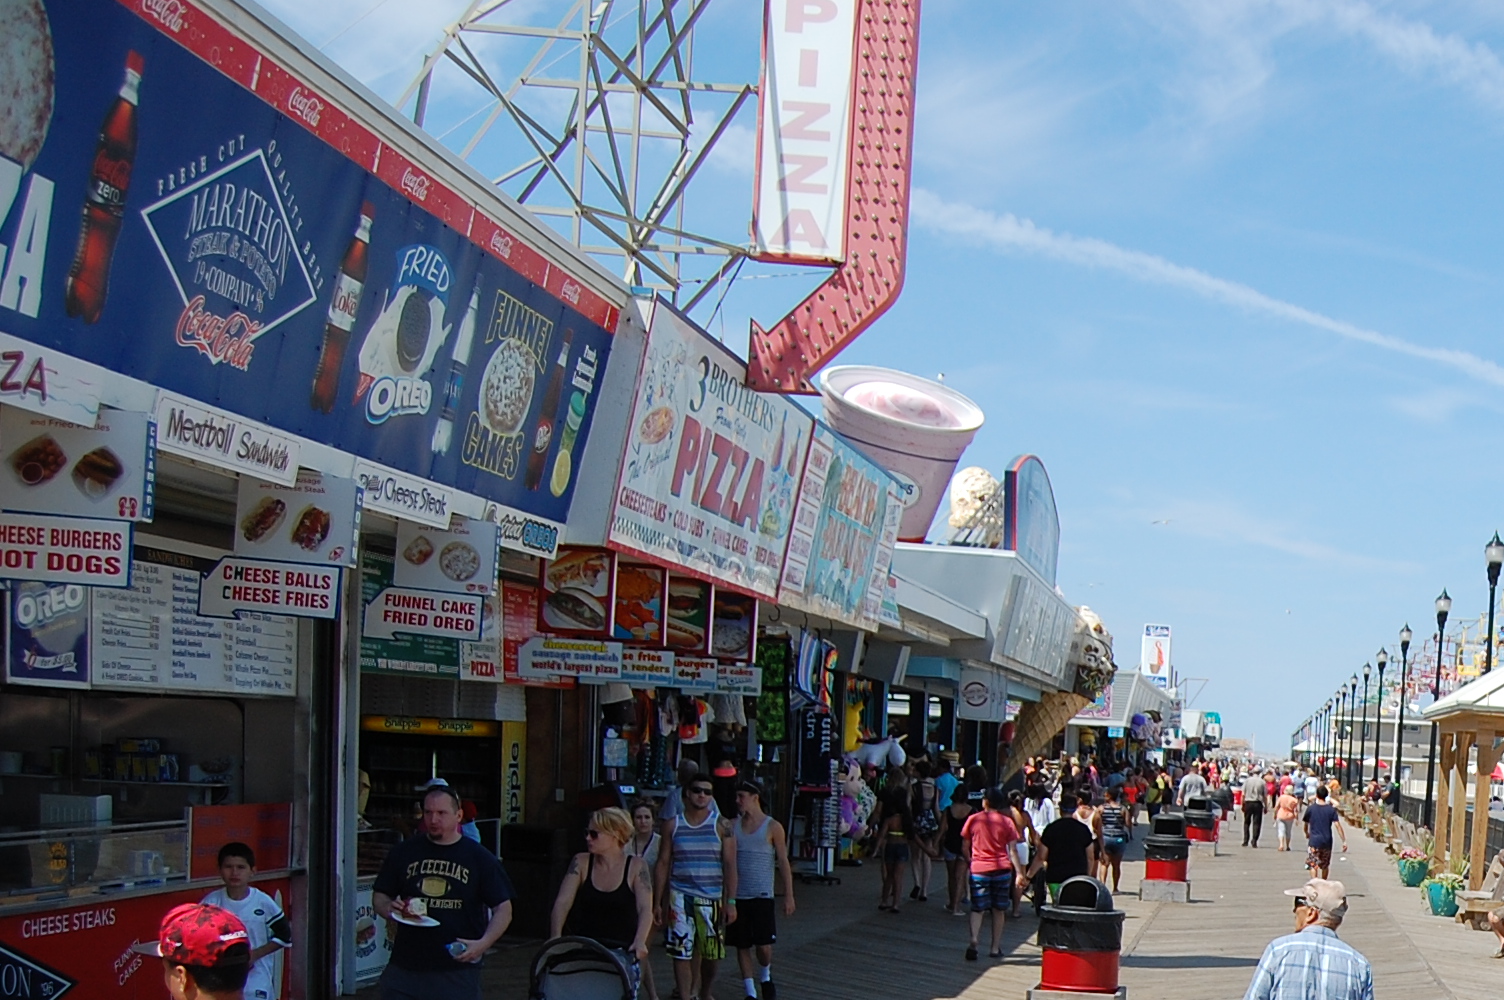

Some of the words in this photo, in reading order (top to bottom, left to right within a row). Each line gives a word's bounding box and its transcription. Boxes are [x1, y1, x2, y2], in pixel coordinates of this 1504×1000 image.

[288, 86, 325, 127] Coca-Cola
[768, 0, 838, 249] PIZZA
[157, 155, 208, 196] FRESH
[218, 134, 246, 162] CUT
[97, 180, 120, 203] zero
[268, 139, 304, 231] QUALITY
[184, 182, 291, 286] MARATHON
[187, 231, 228, 263] STEAK
[399, 246, 451, 292] FRIED
[206, 266, 252, 307] COMPANY
[333, 286, 357, 318] Coke
[176, 295, 264, 371] Coca-Cola
[485, 289, 554, 374] FUNNEL
[368, 377, 432, 421] OREO
[689, 355, 711, 412] 3
[708, 362, 776, 433] BROTHERS
[167, 407, 236, 455] Meatball
[237, 431, 290, 472] Sandwich
[462, 411, 525, 480] CAKES
[671, 414, 765, 533] PIZZA
[421, 489, 447, 516] Steak
[619, 486, 668, 523] CHEESESTEAKS
[673, 509, 689, 532] COLD
[710, 525, 731, 550] FUNNEL
[731, 535, 750, 556] CAKES
[50, 528, 122, 551] BURGERS
[0, 549, 38, 569] OT
[47, 552, 121, 575] DOGS
[223, 564, 281, 587] CHEESE
[285, 568, 331, 590] BALLS
[17, 584, 84, 625] OREO
[222, 584, 280, 605] CHEESE
[285, 590, 329, 610] FRIES
[385, 594, 436, 612] FUNNEL
[441, 600, 476, 615] CAKE
[383, 609, 428, 627] FRIED
[433, 615, 475, 632] OREO
[470, 660, 496, 677] PIZZA
[564, 663, 593, 674] largest
[595, 664, 618, 675] pizza
[574, 653, 619, 663] sandwich
[637, 651, 663, 662] fries
[678, 668, 702, 679] dogs
[384, 718, 421, 729] Snapple
[437, 720, 474, 733] Snapple
[420, 859, 469, 884] CECELIA'S
[429, 898, 463, 909] KNIGHTS
[22, 914, 69, 938] CHEESE
[73, 907, 116, 931] STEAKS
[119, 954, 143, 986] CAKES
